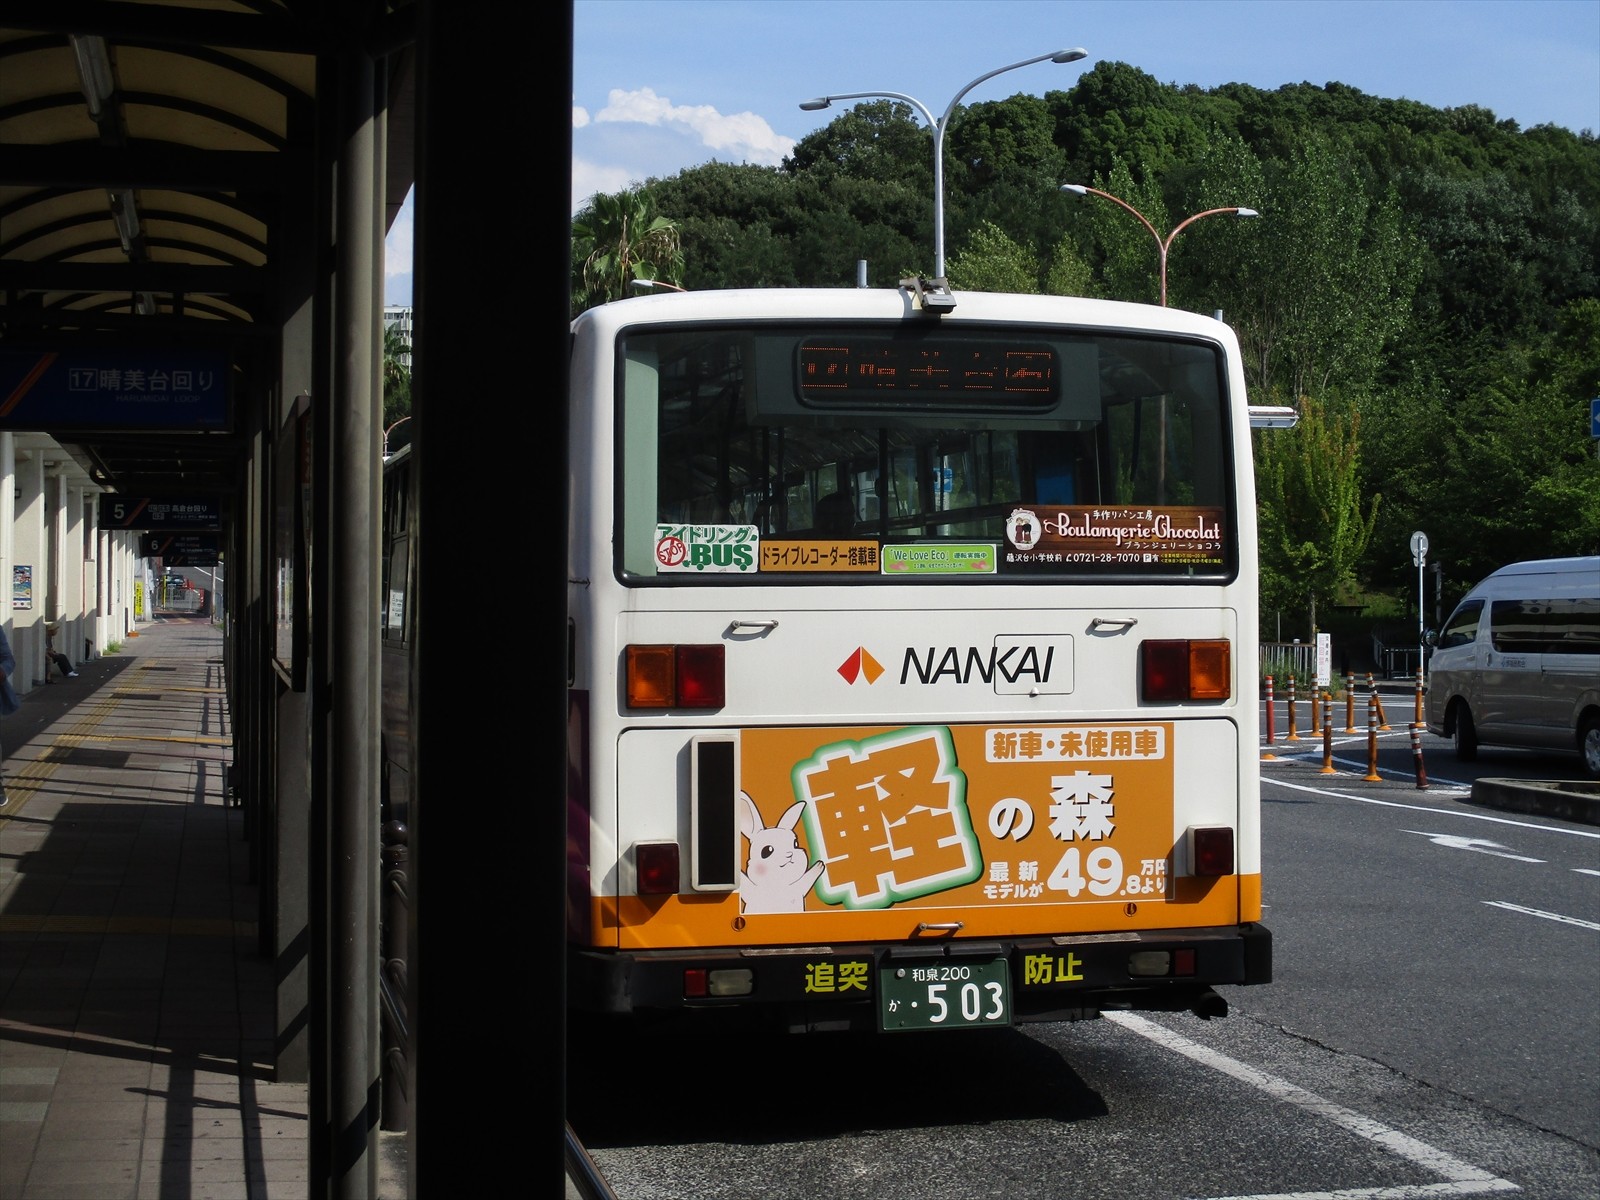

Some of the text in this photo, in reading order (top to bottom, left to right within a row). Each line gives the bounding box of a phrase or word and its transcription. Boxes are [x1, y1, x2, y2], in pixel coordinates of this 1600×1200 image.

[72, 370, 214, 392] 17 晴美台回り
[113, 504, 125, 519] 5
[1092, 510, 1153, 521] 手作りパン工房
[1044, 512, 1221, 545] Boulangerie Chocolat
[151, 539, 159, 551] 6
[658, 541, 753, 570] STOP BUS
[910, 550, 929, 560] Love
[762, 545, 878, 567] ドライブレコーダー搭載車
[1073, 553, 1140, 563] 0721-28-7070
[900, 646, 1055, 685] NANKAI
[993, 730, 1158, 760] 新車・未使用車
[989, 861, 1039, 882] 最新
[983, 882, 1044, 900] モデルが
[805, 952, 1084, 994] 追突 防止
[888, 999, 901, 1013] か
